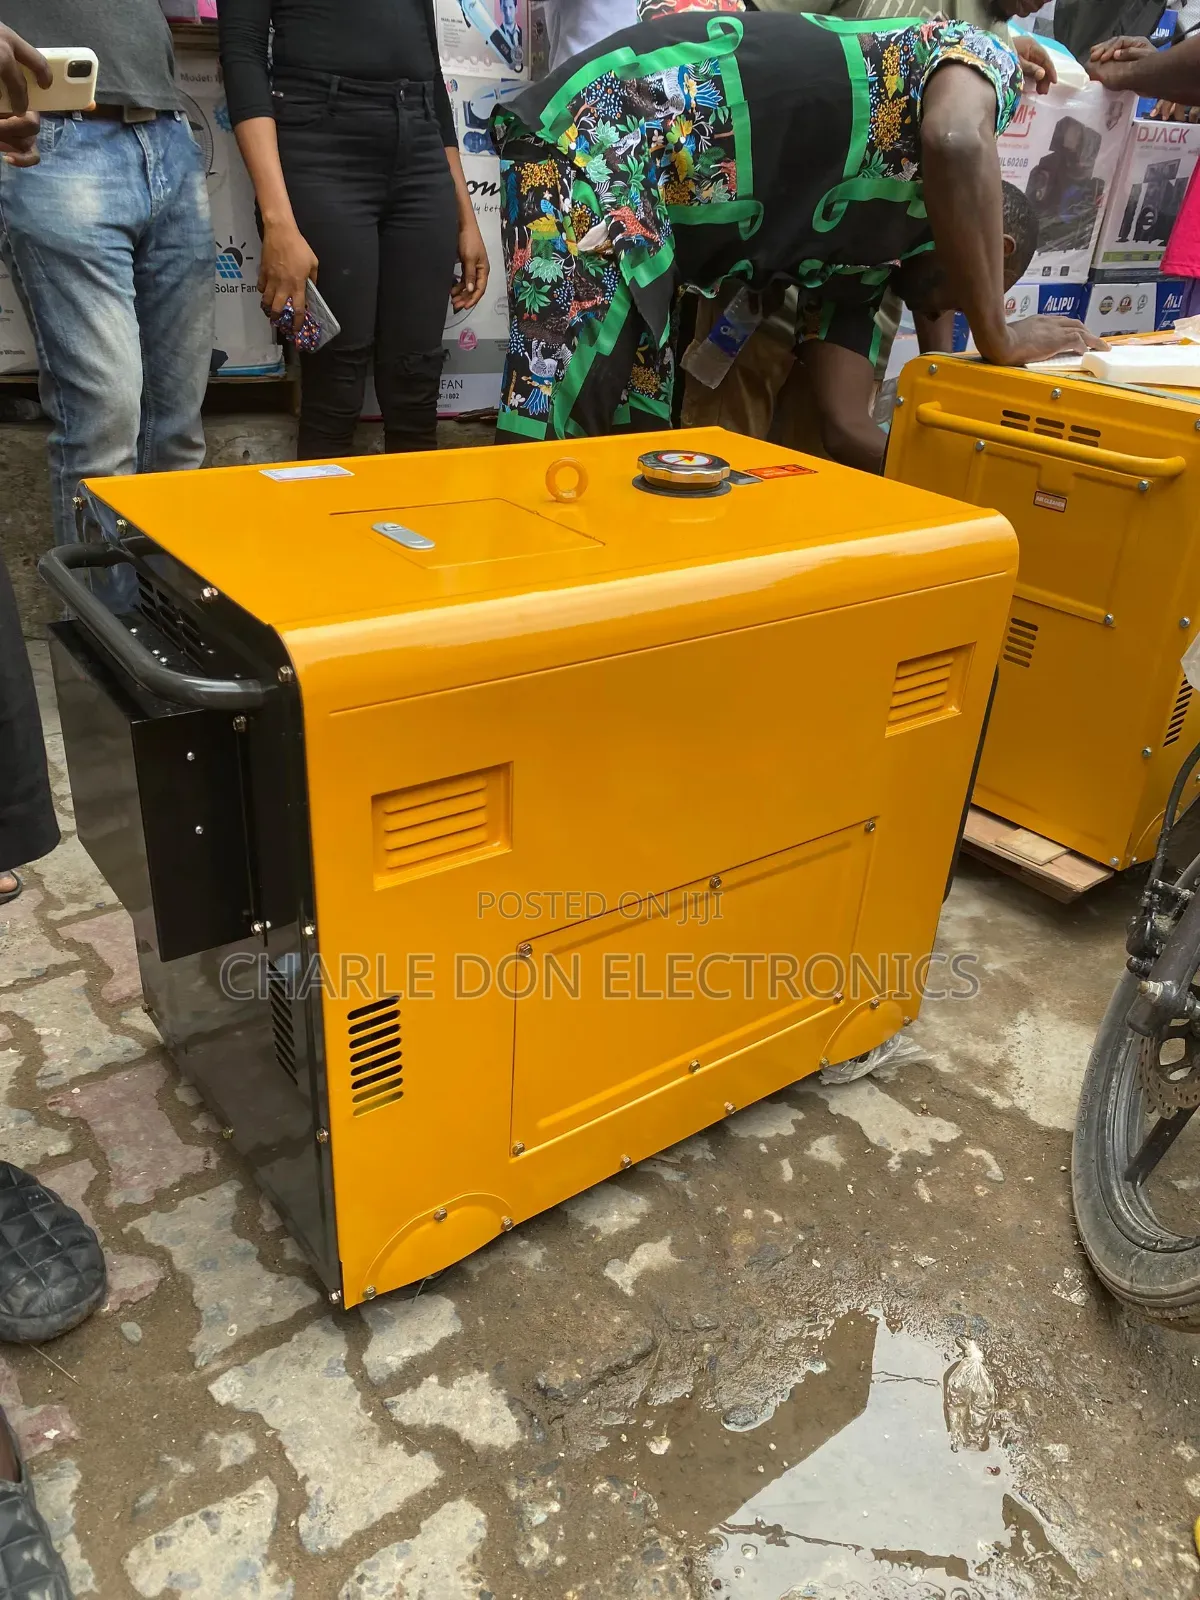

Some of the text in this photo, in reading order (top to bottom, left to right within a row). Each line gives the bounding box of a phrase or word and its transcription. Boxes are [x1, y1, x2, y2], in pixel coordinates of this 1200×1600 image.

[180, 72, 213, 83] Model:
[1137, 126, 1190, 144] DJACK
[215, 283, 240, 293] Solar
[441, 379, 463, 390] FAN
